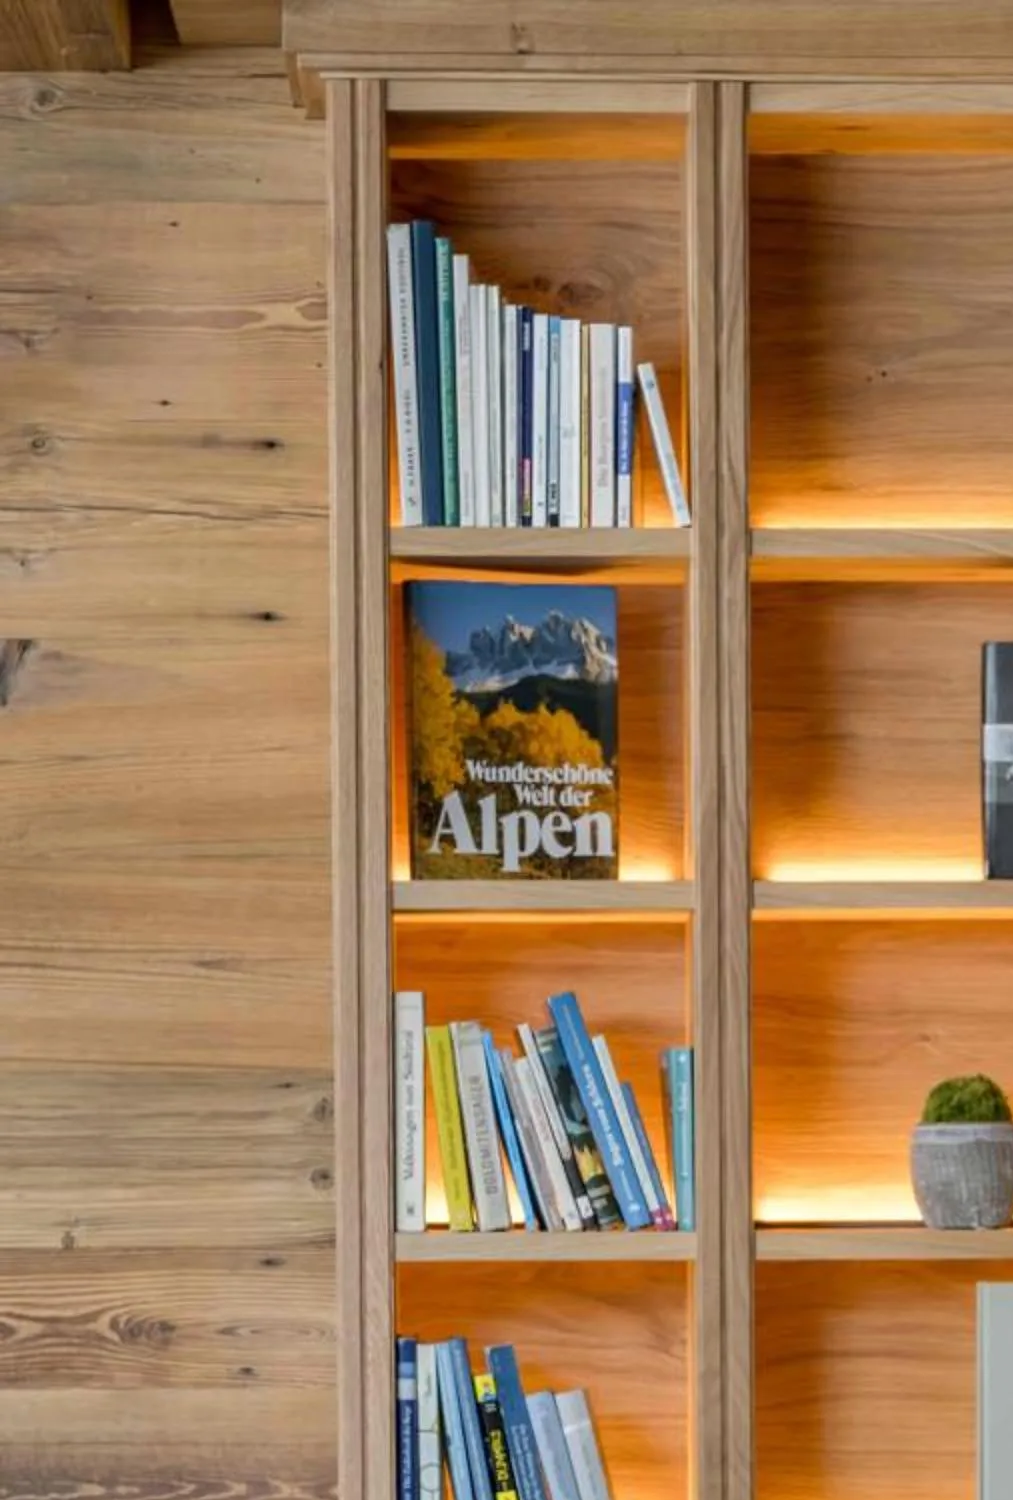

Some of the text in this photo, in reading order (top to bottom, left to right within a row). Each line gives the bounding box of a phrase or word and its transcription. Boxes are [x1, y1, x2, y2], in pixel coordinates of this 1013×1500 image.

[466, 760, 613, 784] Wunderschöne
[514, 783, 593, 807] Welt der
[427, 790, 615, 873] Alpen
